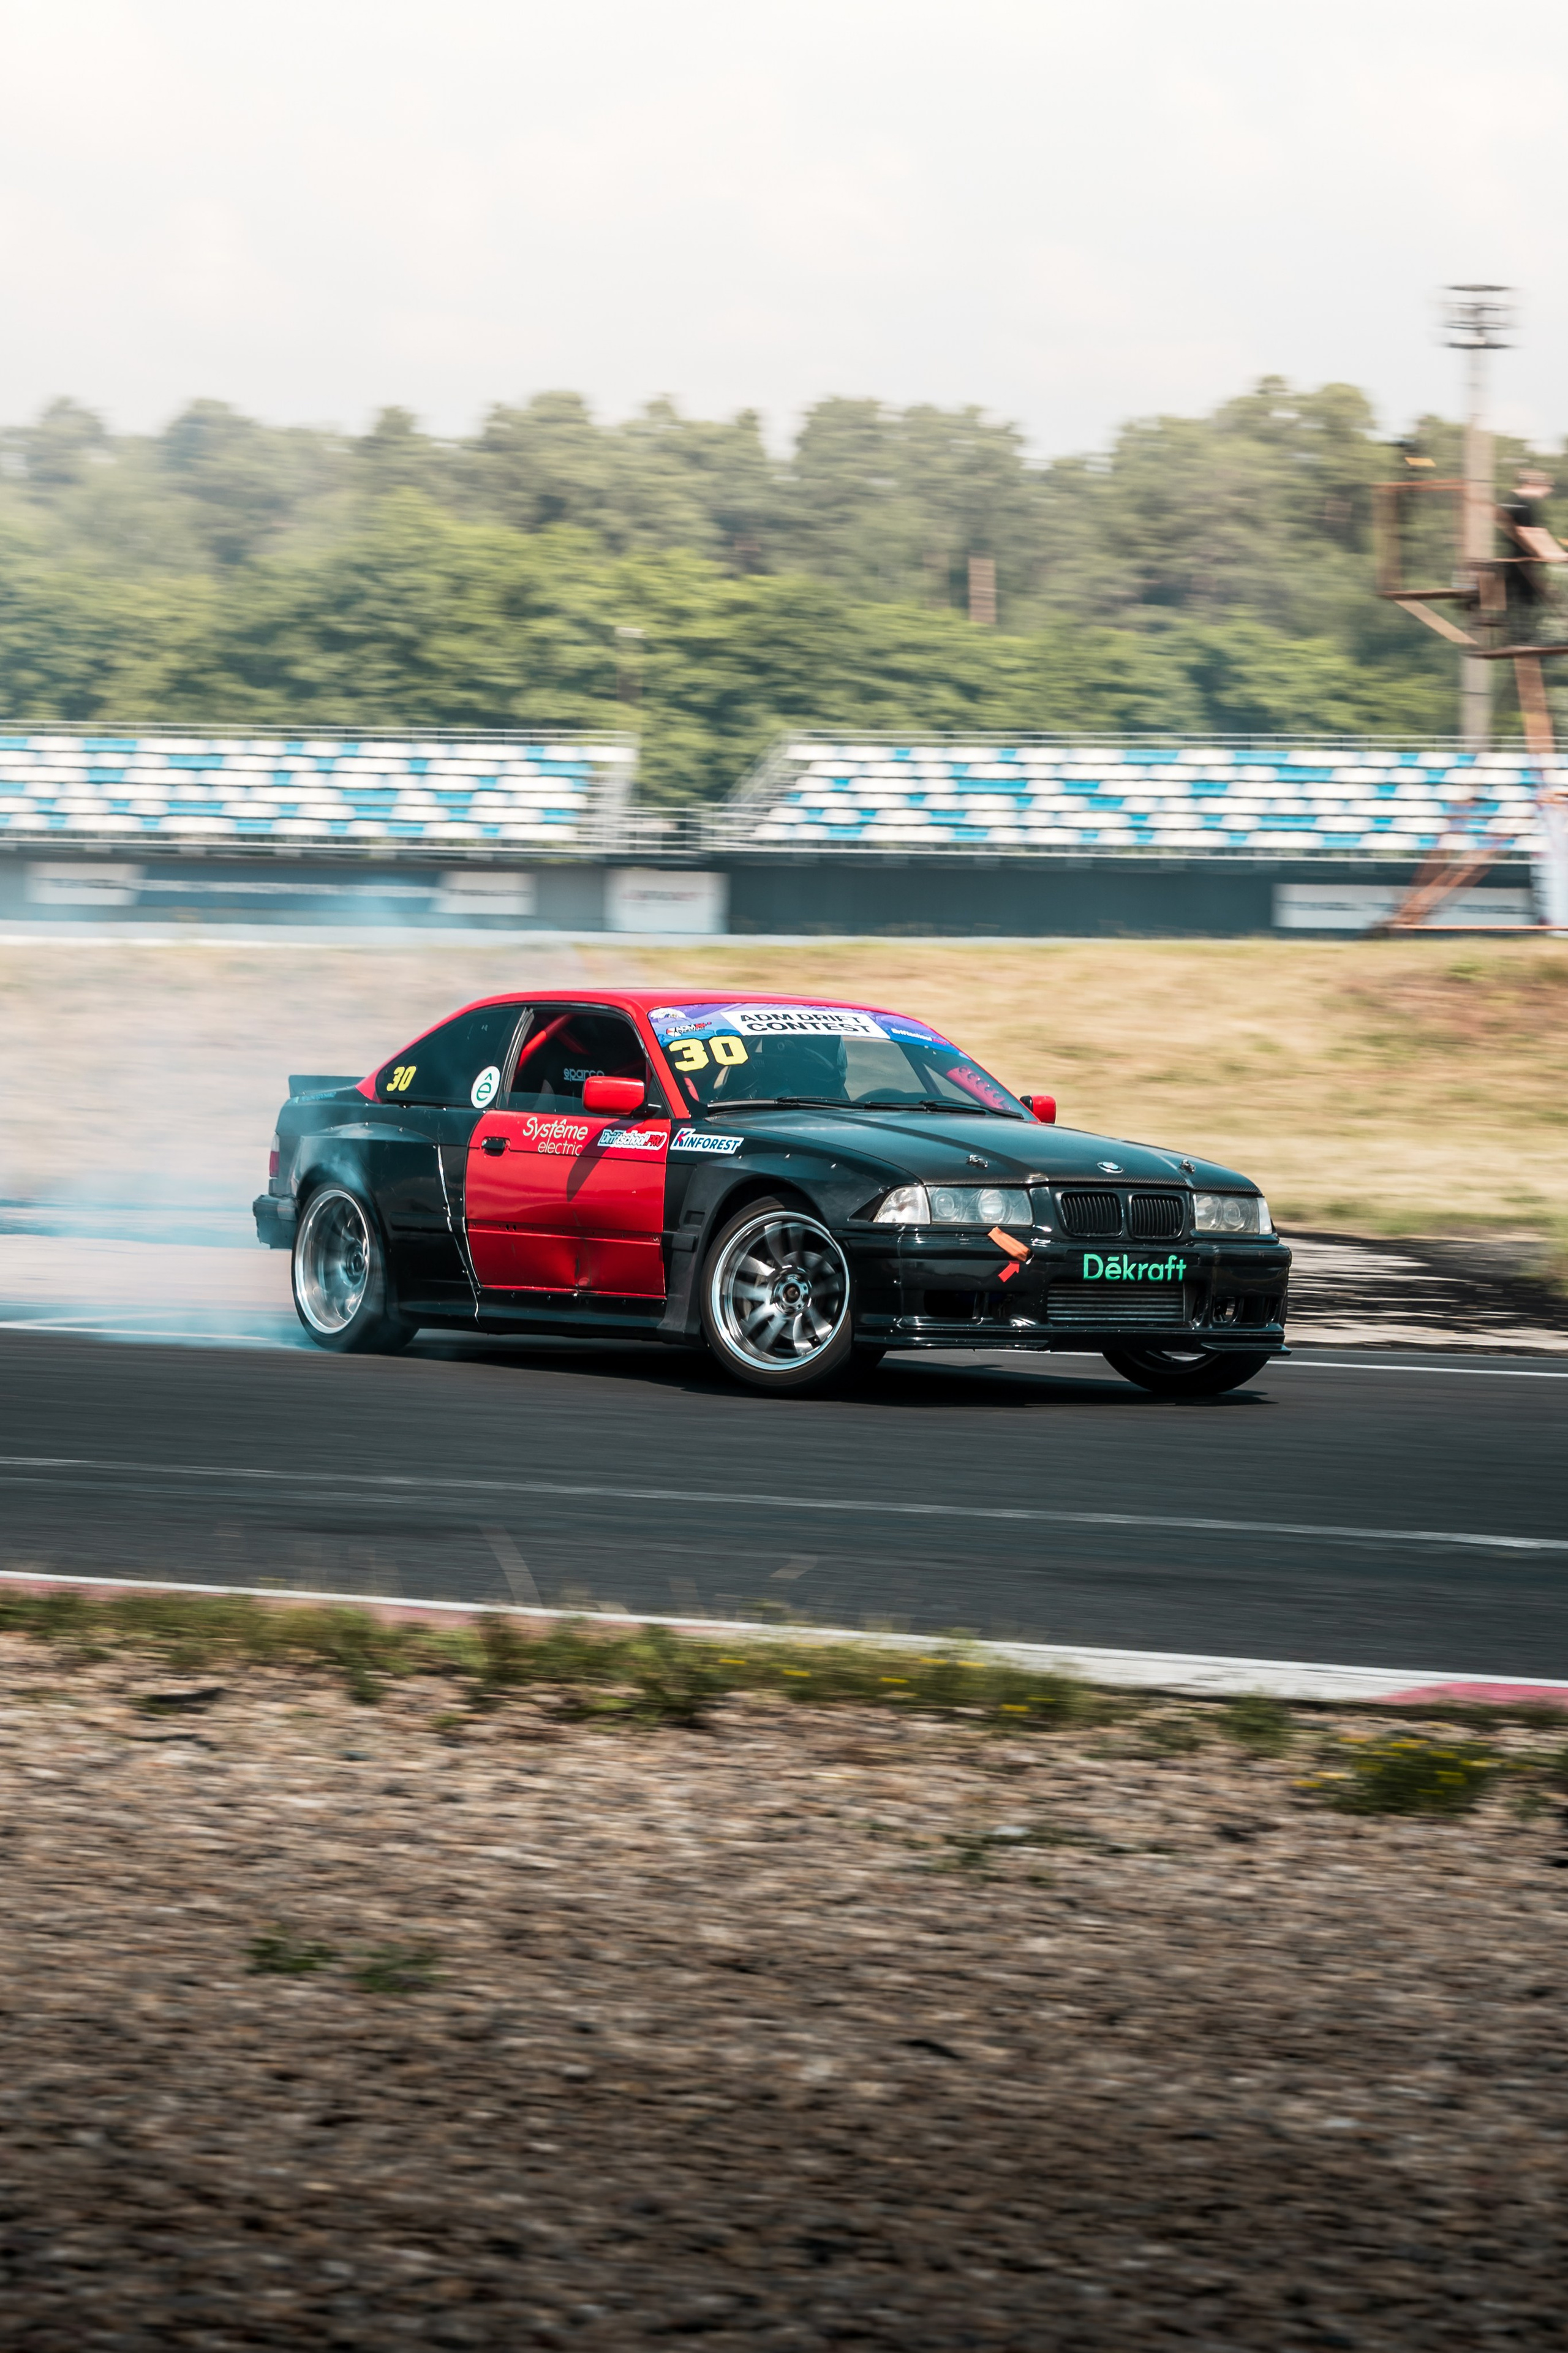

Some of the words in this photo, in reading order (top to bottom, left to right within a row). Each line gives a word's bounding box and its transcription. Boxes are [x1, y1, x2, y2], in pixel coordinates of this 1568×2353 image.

[741, 1013, 794, 1022] ADM
[796, 1013, 862, 1024] DRIFT
[746, 1022, 871, 1033] CONTEST
[668, 1035, 748, 1071] 30
[386, 1065, 417, 1091] 30
[522, 1117, 588, 1141] Systême
[538, 1138, 582, 1156] electric
[674, 1130, 741, 1151] KINFOREST
[1083, 1253, 1187, 1282] Dēkraft
